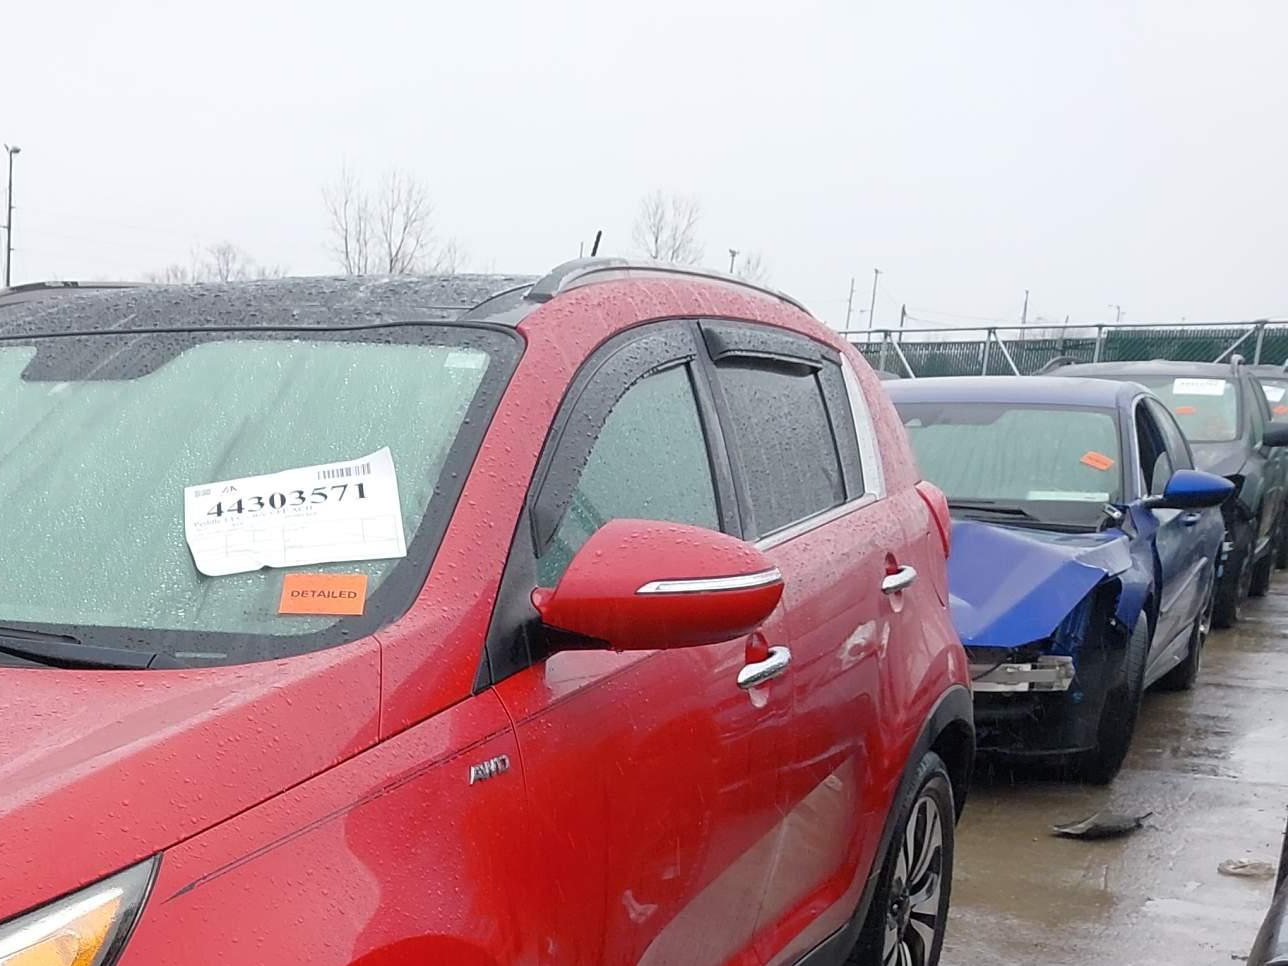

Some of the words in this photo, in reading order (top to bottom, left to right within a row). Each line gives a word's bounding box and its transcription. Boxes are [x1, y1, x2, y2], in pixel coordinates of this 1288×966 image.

[206, 482, 369, 518] 44303571
[290, 590, 358, 599] DETAILED
[469, 754, 510, 785] AWD
